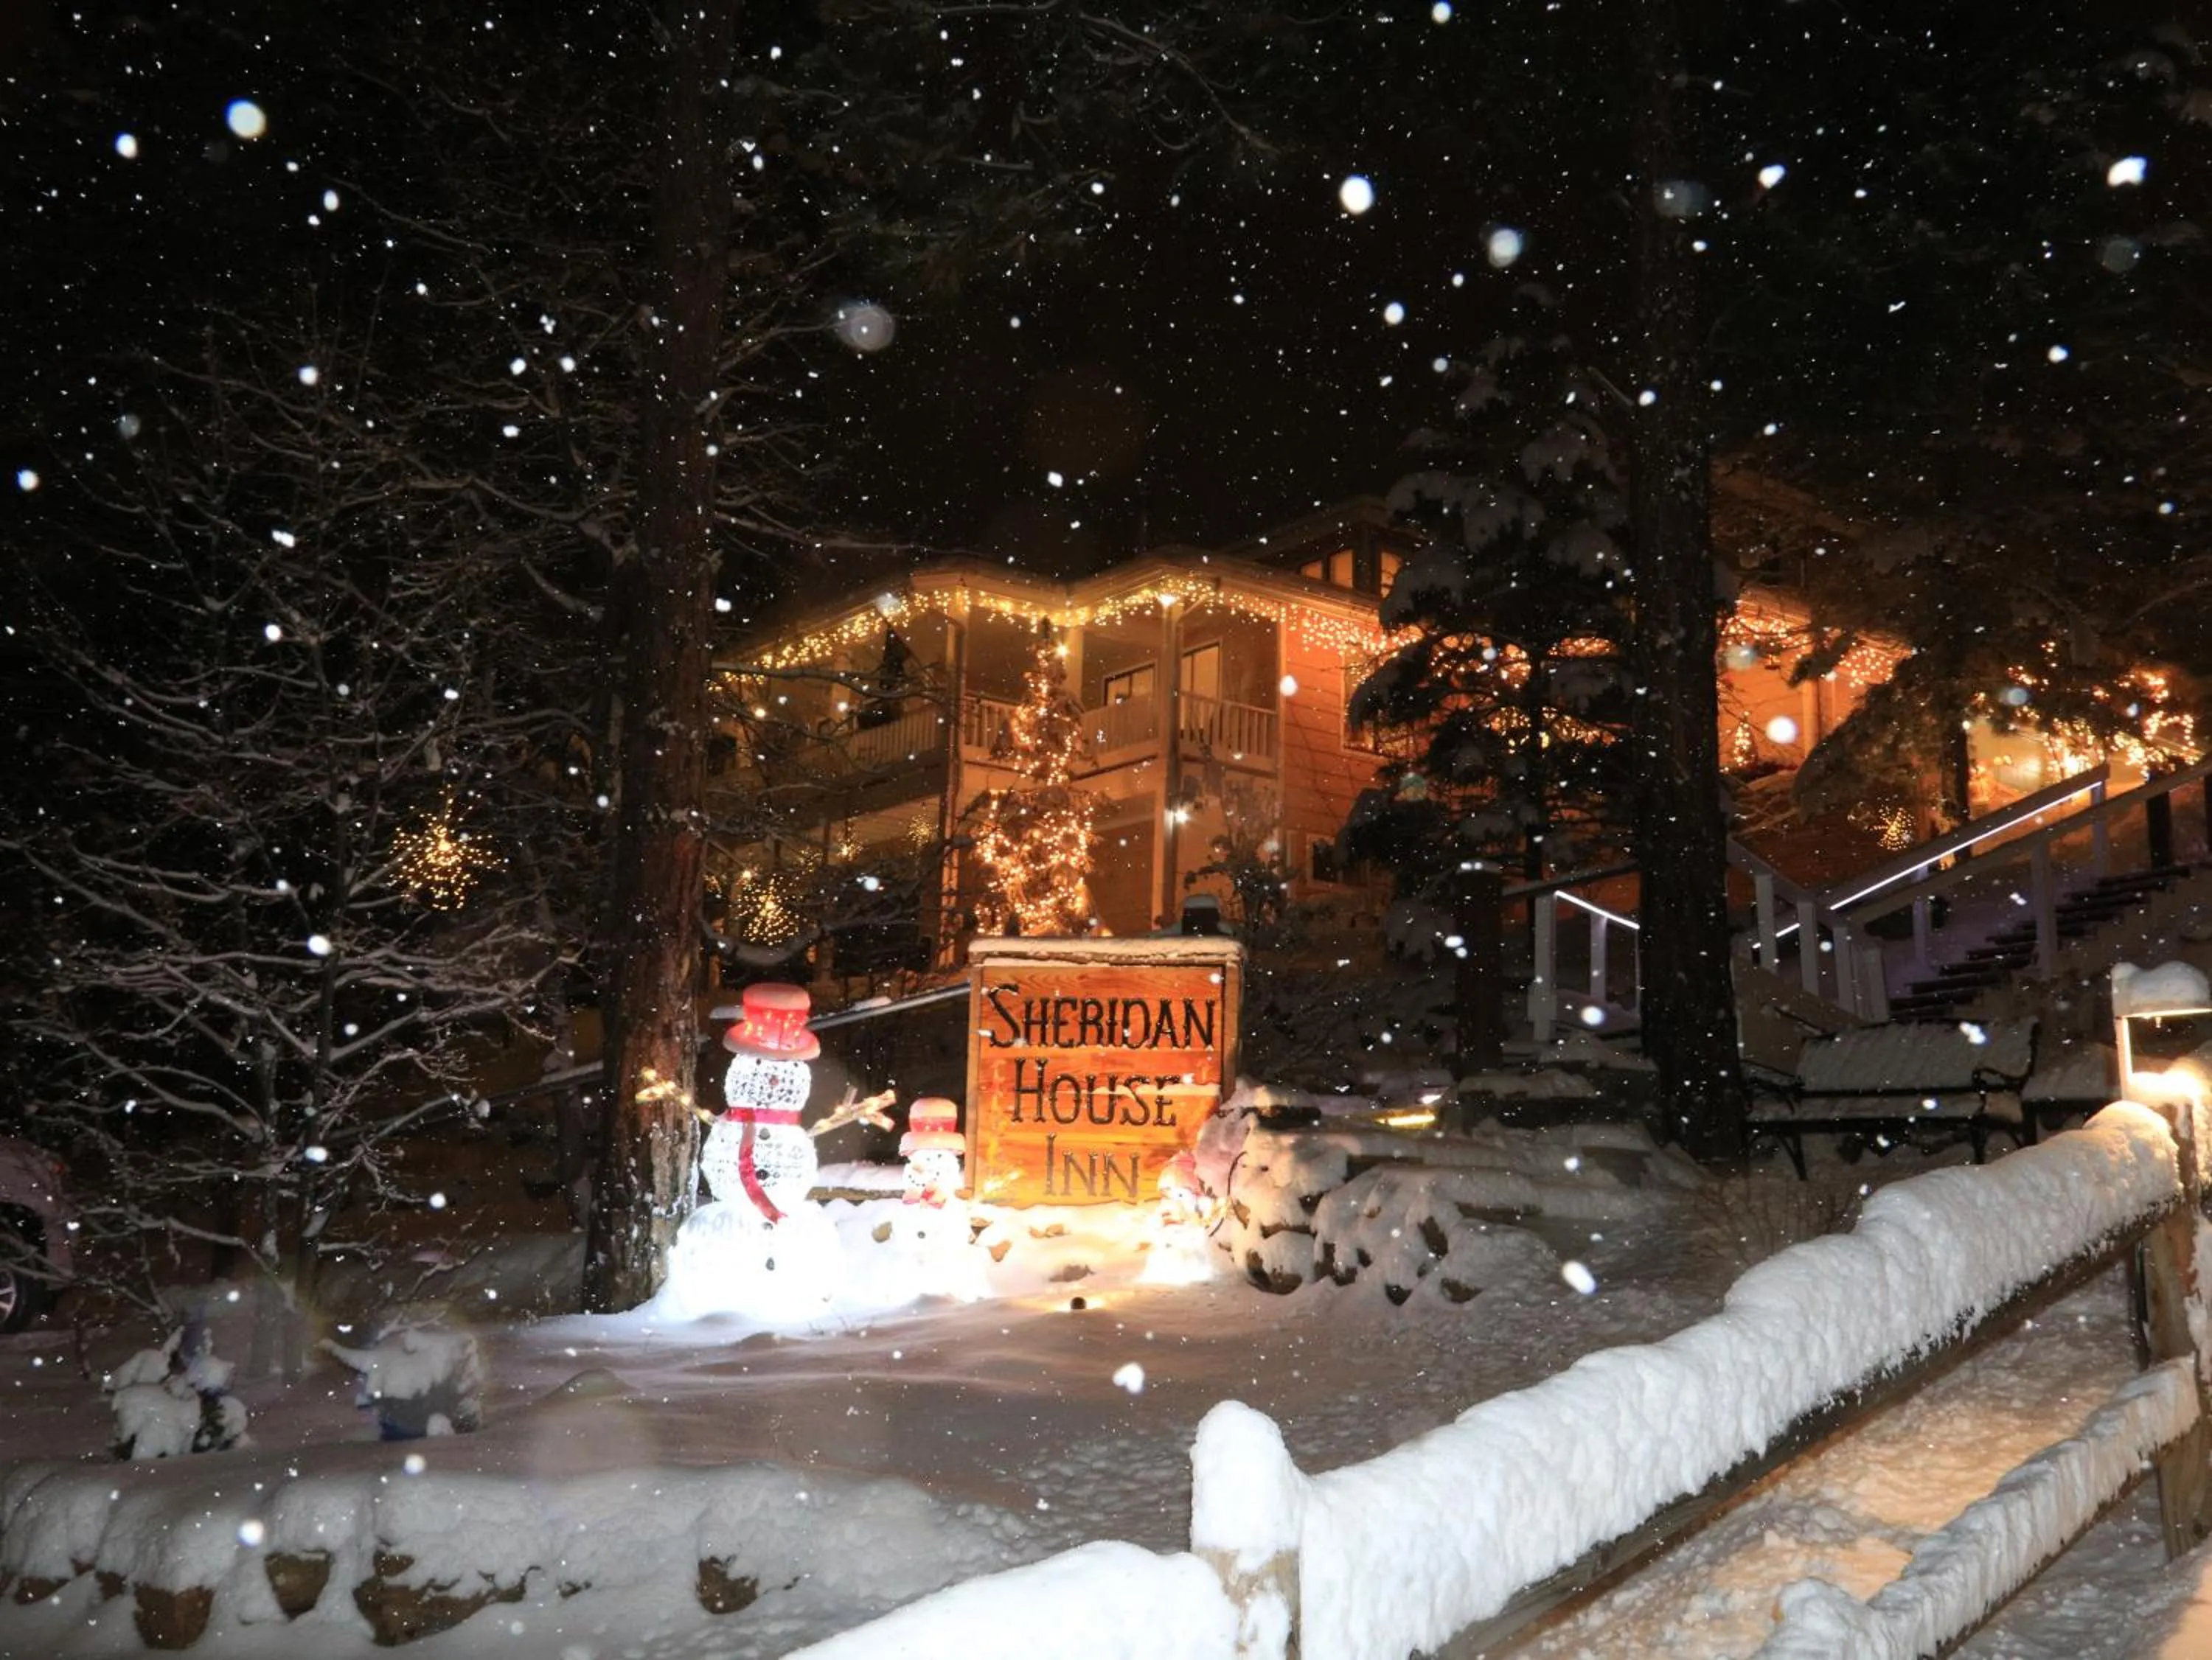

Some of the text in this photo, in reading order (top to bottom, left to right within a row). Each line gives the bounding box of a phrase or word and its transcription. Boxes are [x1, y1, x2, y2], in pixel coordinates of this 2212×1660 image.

[987, 983, 1216, 1051] SHERIDAN
[1011, 1056, 1181, 1127] HOUSE
[1043, 1132, 1141, 1198] INN
